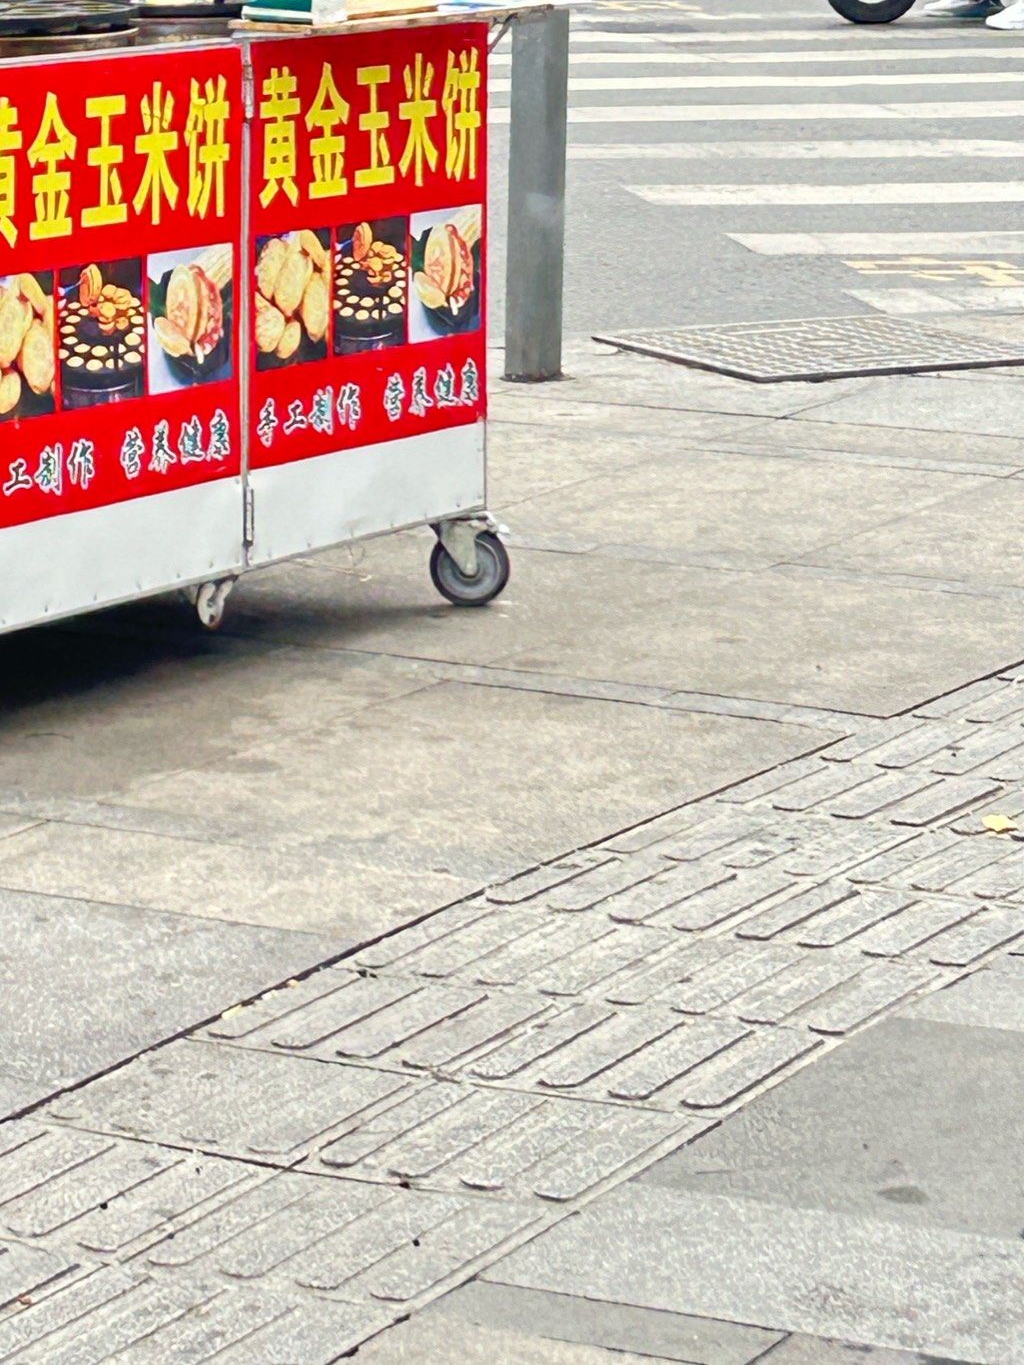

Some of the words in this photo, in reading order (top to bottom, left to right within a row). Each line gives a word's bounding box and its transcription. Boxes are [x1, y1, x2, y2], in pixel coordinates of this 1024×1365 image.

[259, 47, 481, 208] 黄金玉米饼
[120, 408, 231, 479] 营养健康
[257, 383, 361, 447] 手工制作
[383, 357, 480, 417] 营养健康
